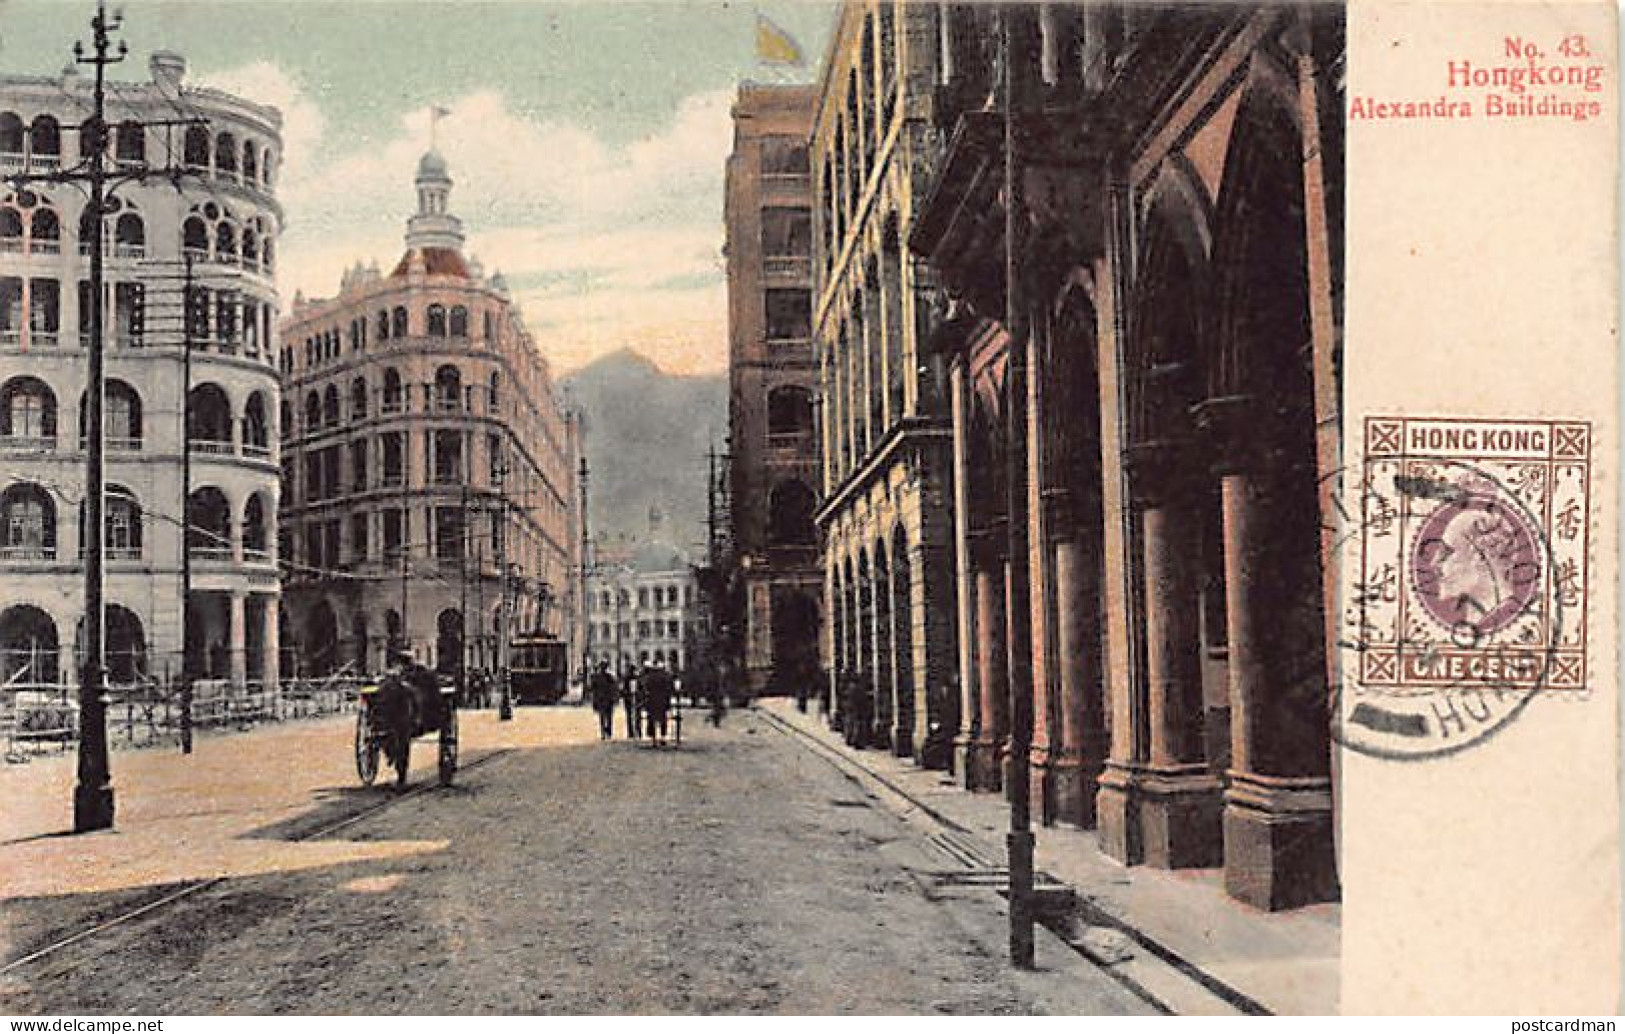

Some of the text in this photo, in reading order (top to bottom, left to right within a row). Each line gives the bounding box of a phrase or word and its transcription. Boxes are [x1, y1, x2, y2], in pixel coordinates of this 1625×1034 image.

[1505, 34, 1591, 58] No. 43.
[1448, 60, 1604, 93] Hongkong
[1349, 94, 1602, 121] Alexandra Buildings
[1411, 427, 1546, 452] HONG KONG
[1413, 655, 1464, 678] ONE
